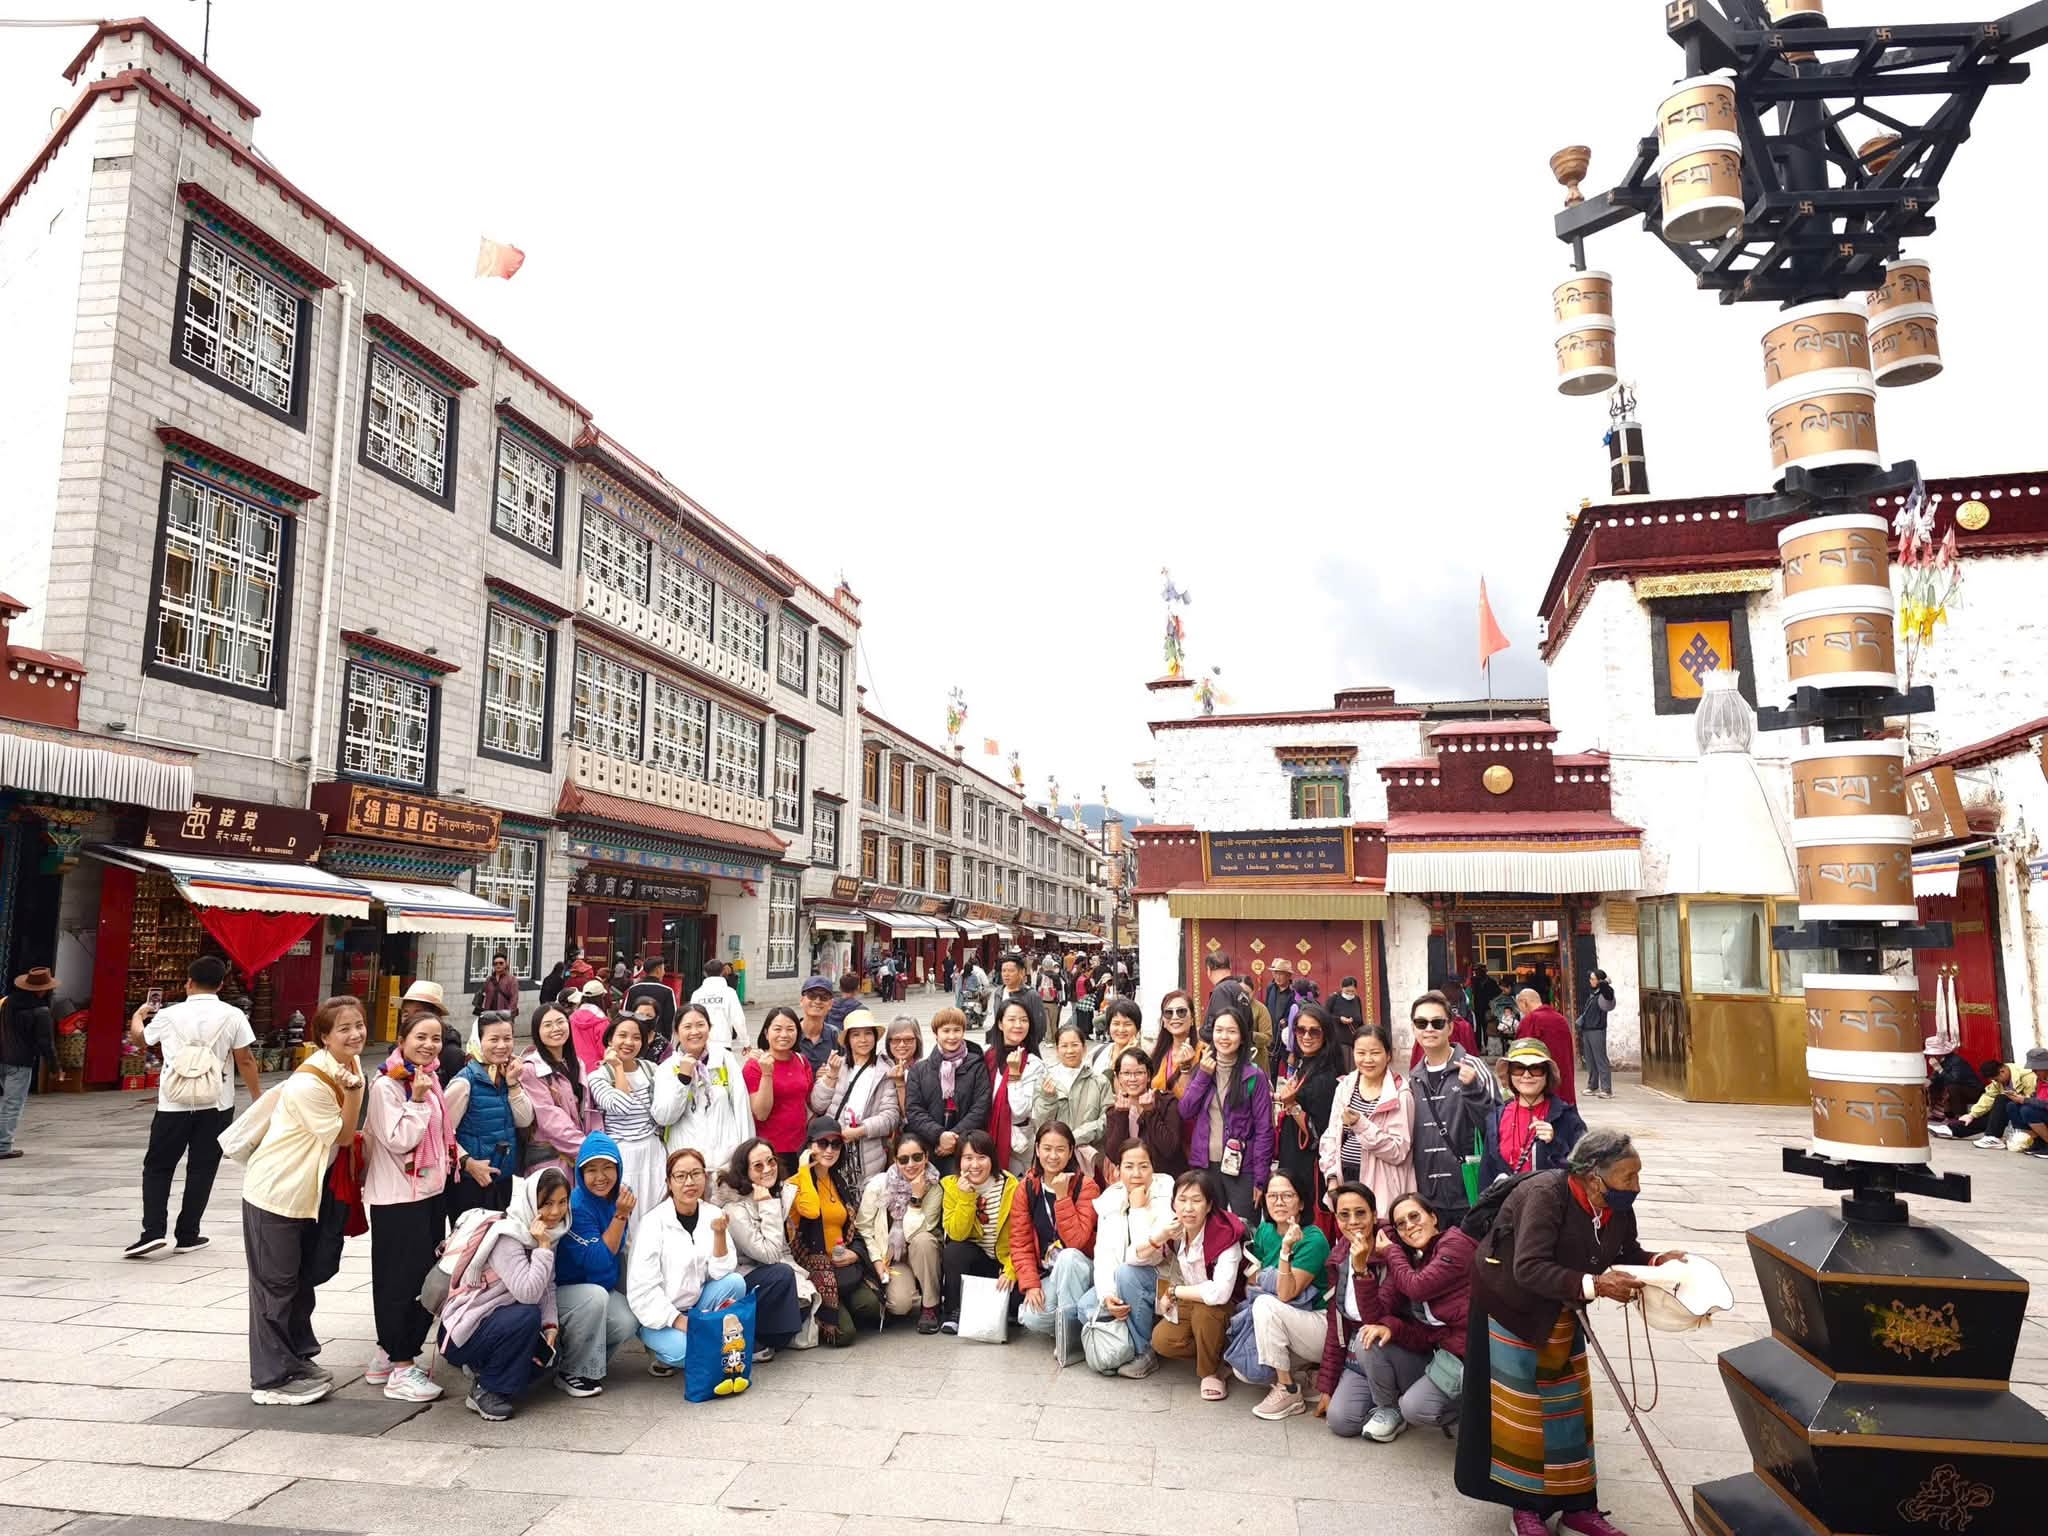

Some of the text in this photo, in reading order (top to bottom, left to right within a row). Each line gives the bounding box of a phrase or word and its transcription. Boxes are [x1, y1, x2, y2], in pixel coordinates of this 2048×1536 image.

[218, 807, 259, 831] 诺觉
[363, 799, 439, 832] 缘遇酒店
